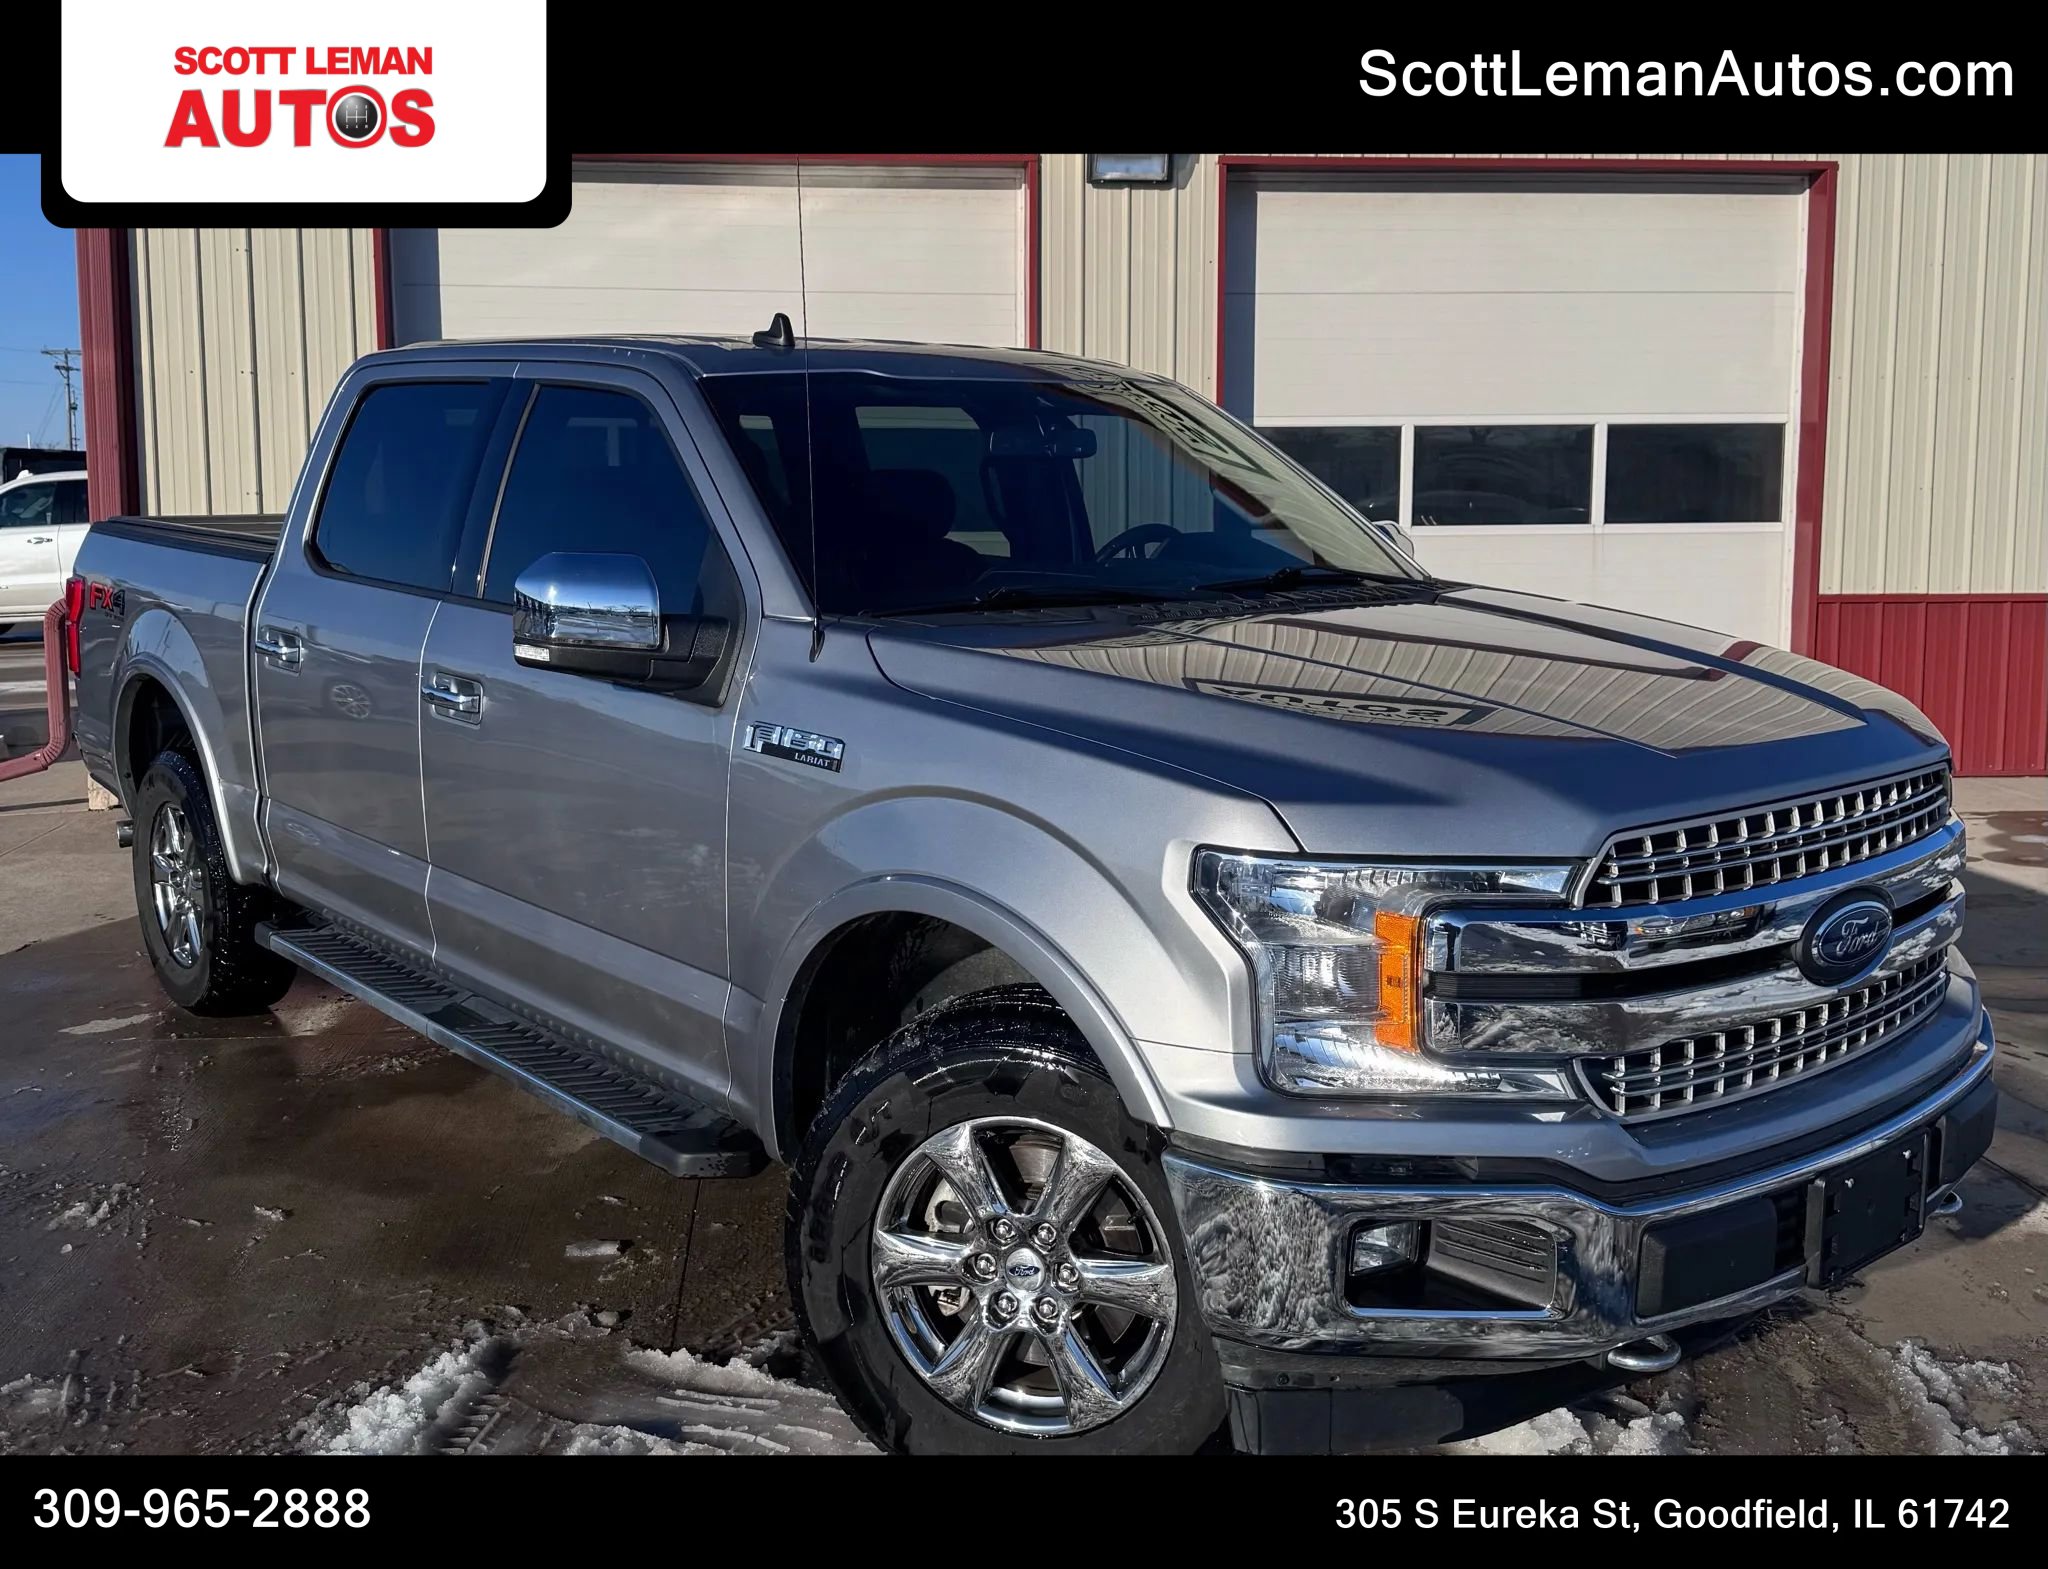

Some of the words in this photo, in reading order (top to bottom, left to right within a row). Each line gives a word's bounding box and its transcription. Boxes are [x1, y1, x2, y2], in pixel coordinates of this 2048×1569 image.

[89, 581, 126, 616] FX4
[794, 752, 831, 768] LARIAT
[1835, 916, 1880, 957] Ford
